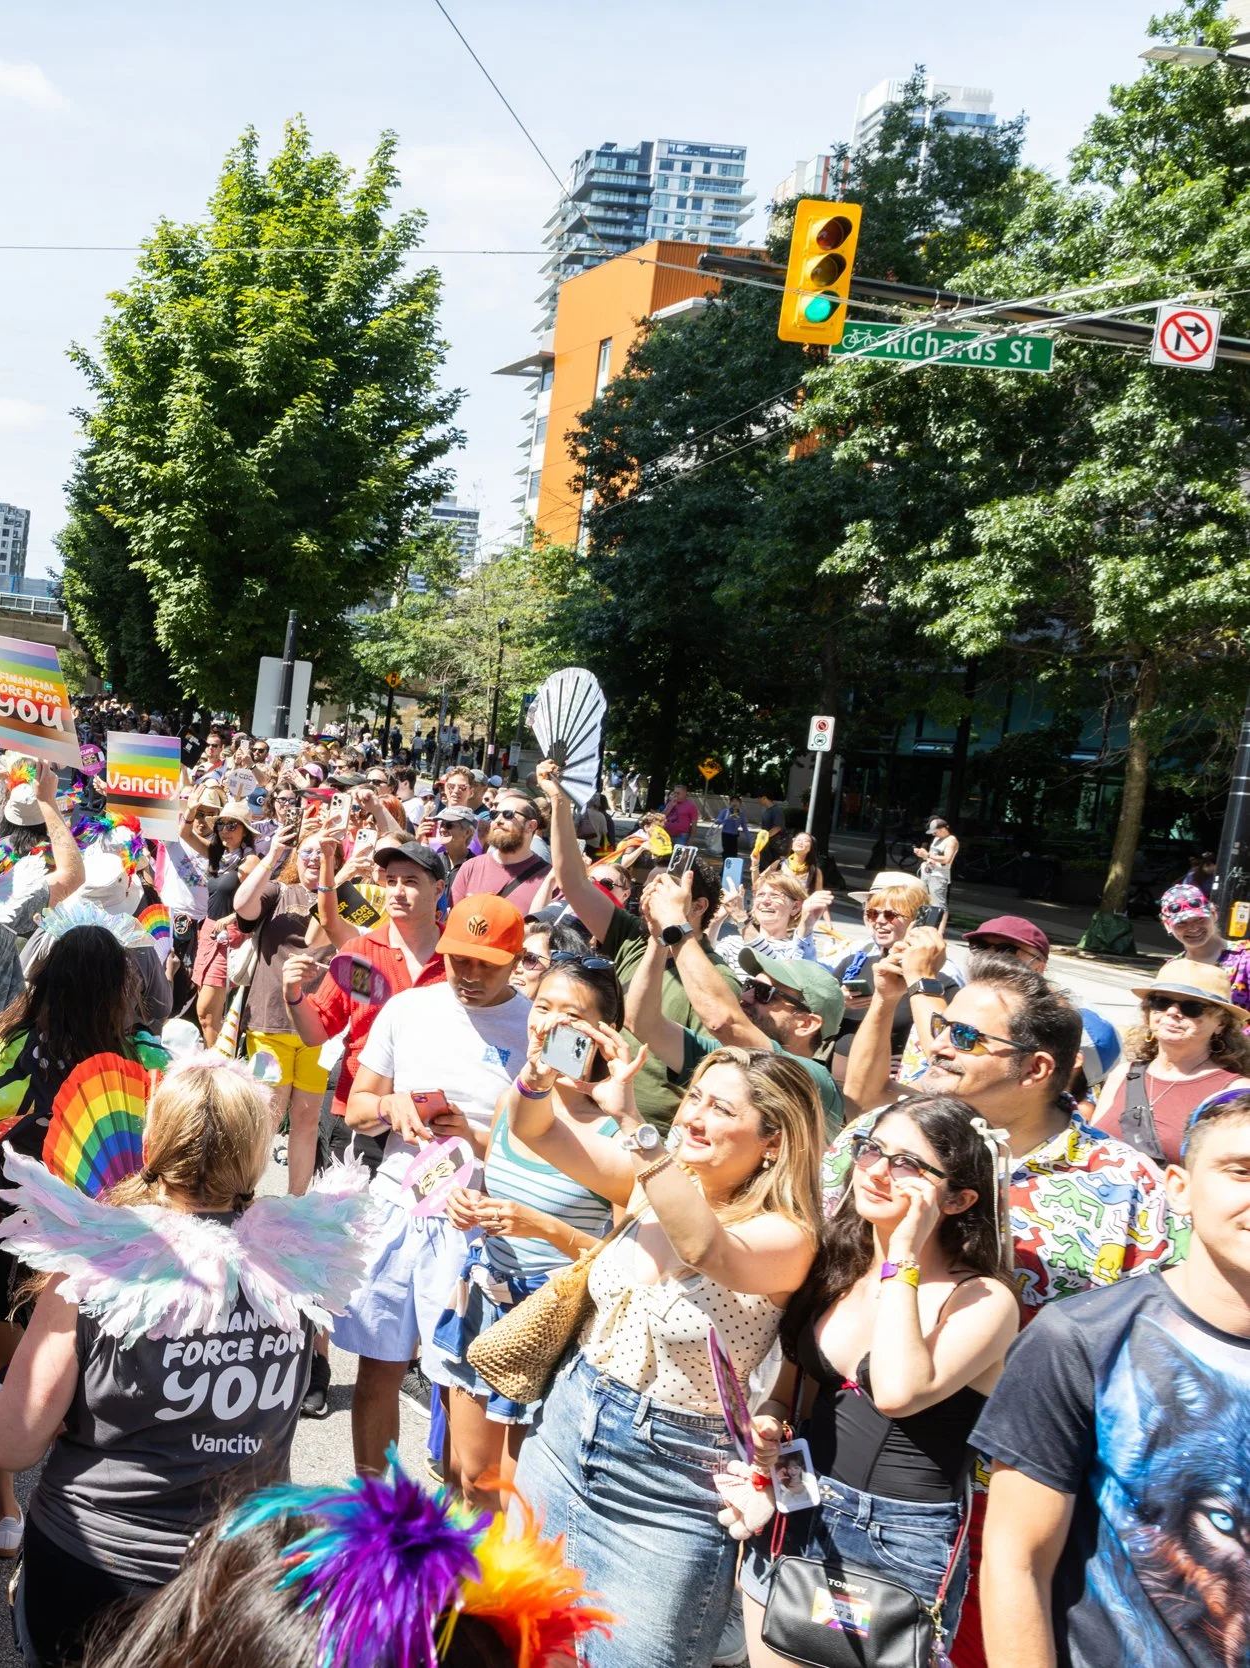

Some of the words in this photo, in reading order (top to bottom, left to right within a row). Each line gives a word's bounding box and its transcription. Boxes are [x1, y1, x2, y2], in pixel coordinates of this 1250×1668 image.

[1008, 340, 1034, 364] St
[35, 691, 62, 706] FOR
[106, 771, 180, 801] Vancity
[351, 904, 370, 920] FOR
[162, 1336, 255, 1369] FORCE
[191, 1433, 262, 1454] Vancity
[827, 1578, 867, 1594] TOMMY
